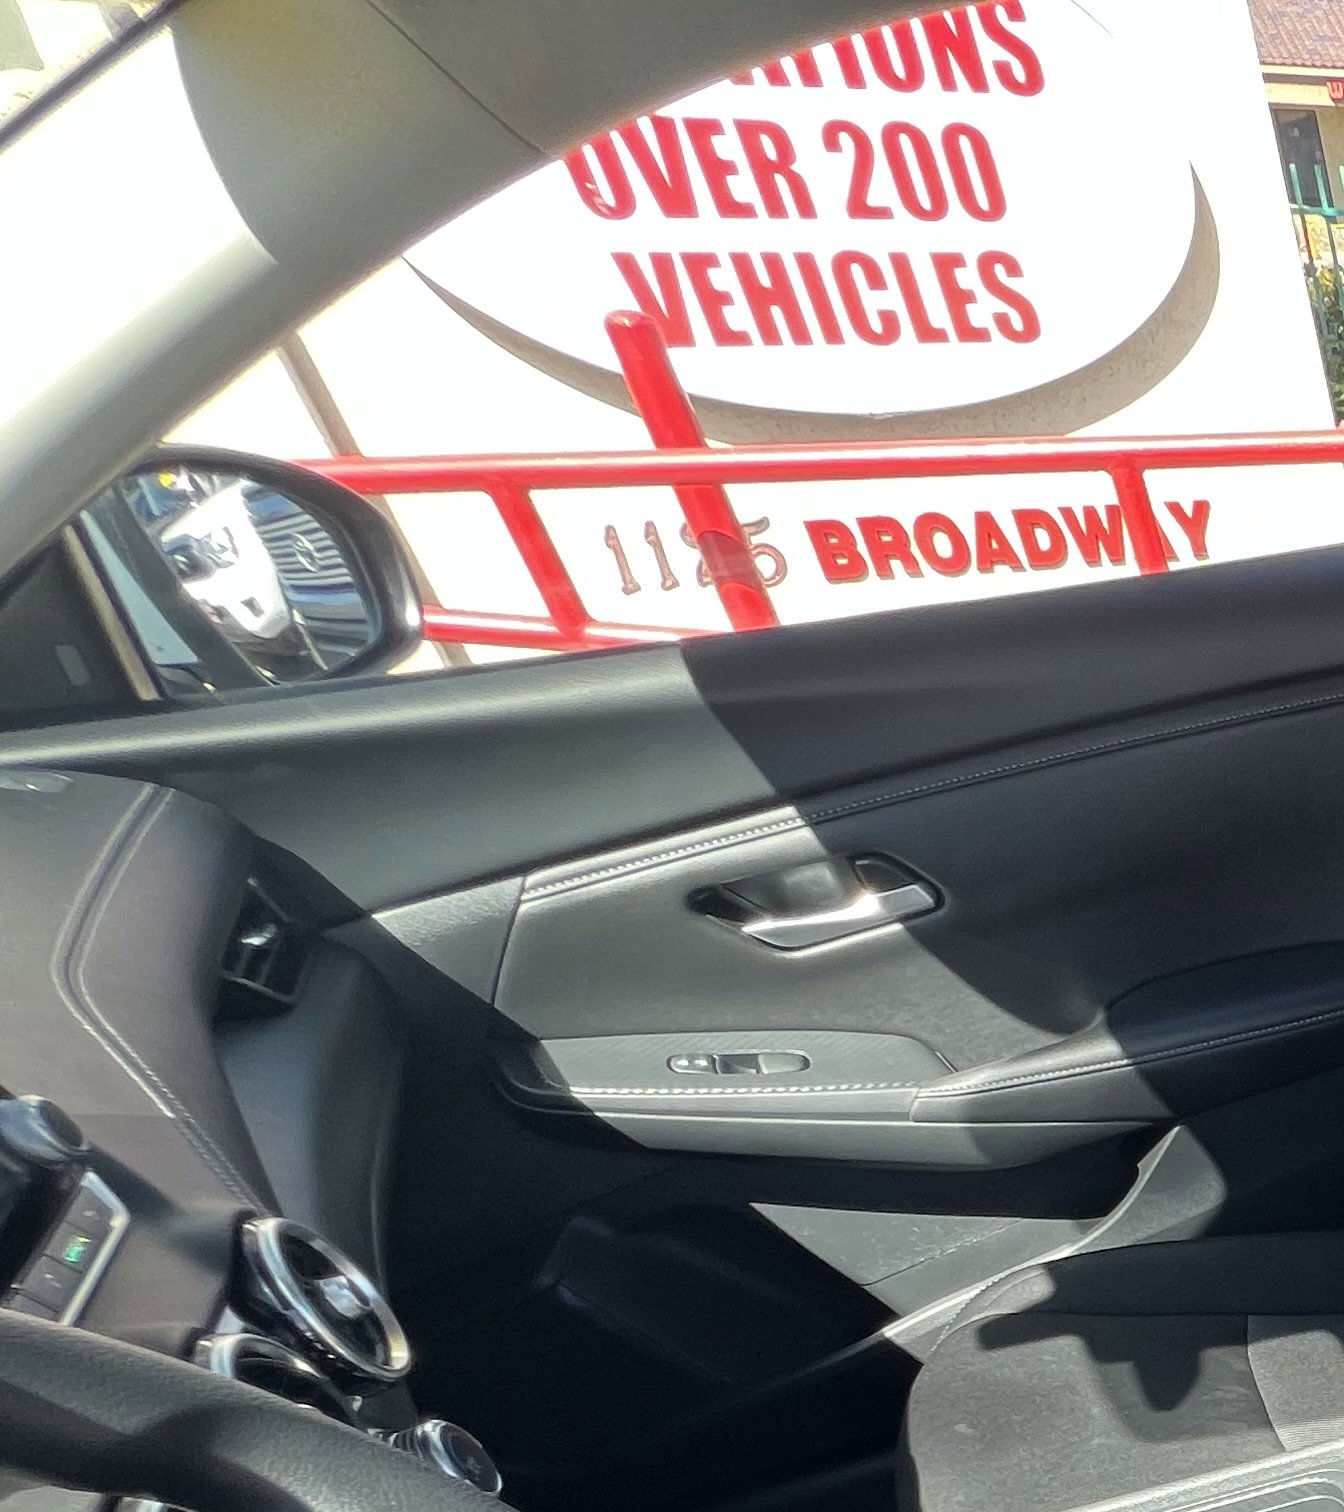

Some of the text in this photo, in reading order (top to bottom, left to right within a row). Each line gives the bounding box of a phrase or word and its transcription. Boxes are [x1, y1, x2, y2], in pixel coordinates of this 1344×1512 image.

[564, 114, 1008, 222] OVER 200
[610, 250, 1042, 348] VEHICLES
